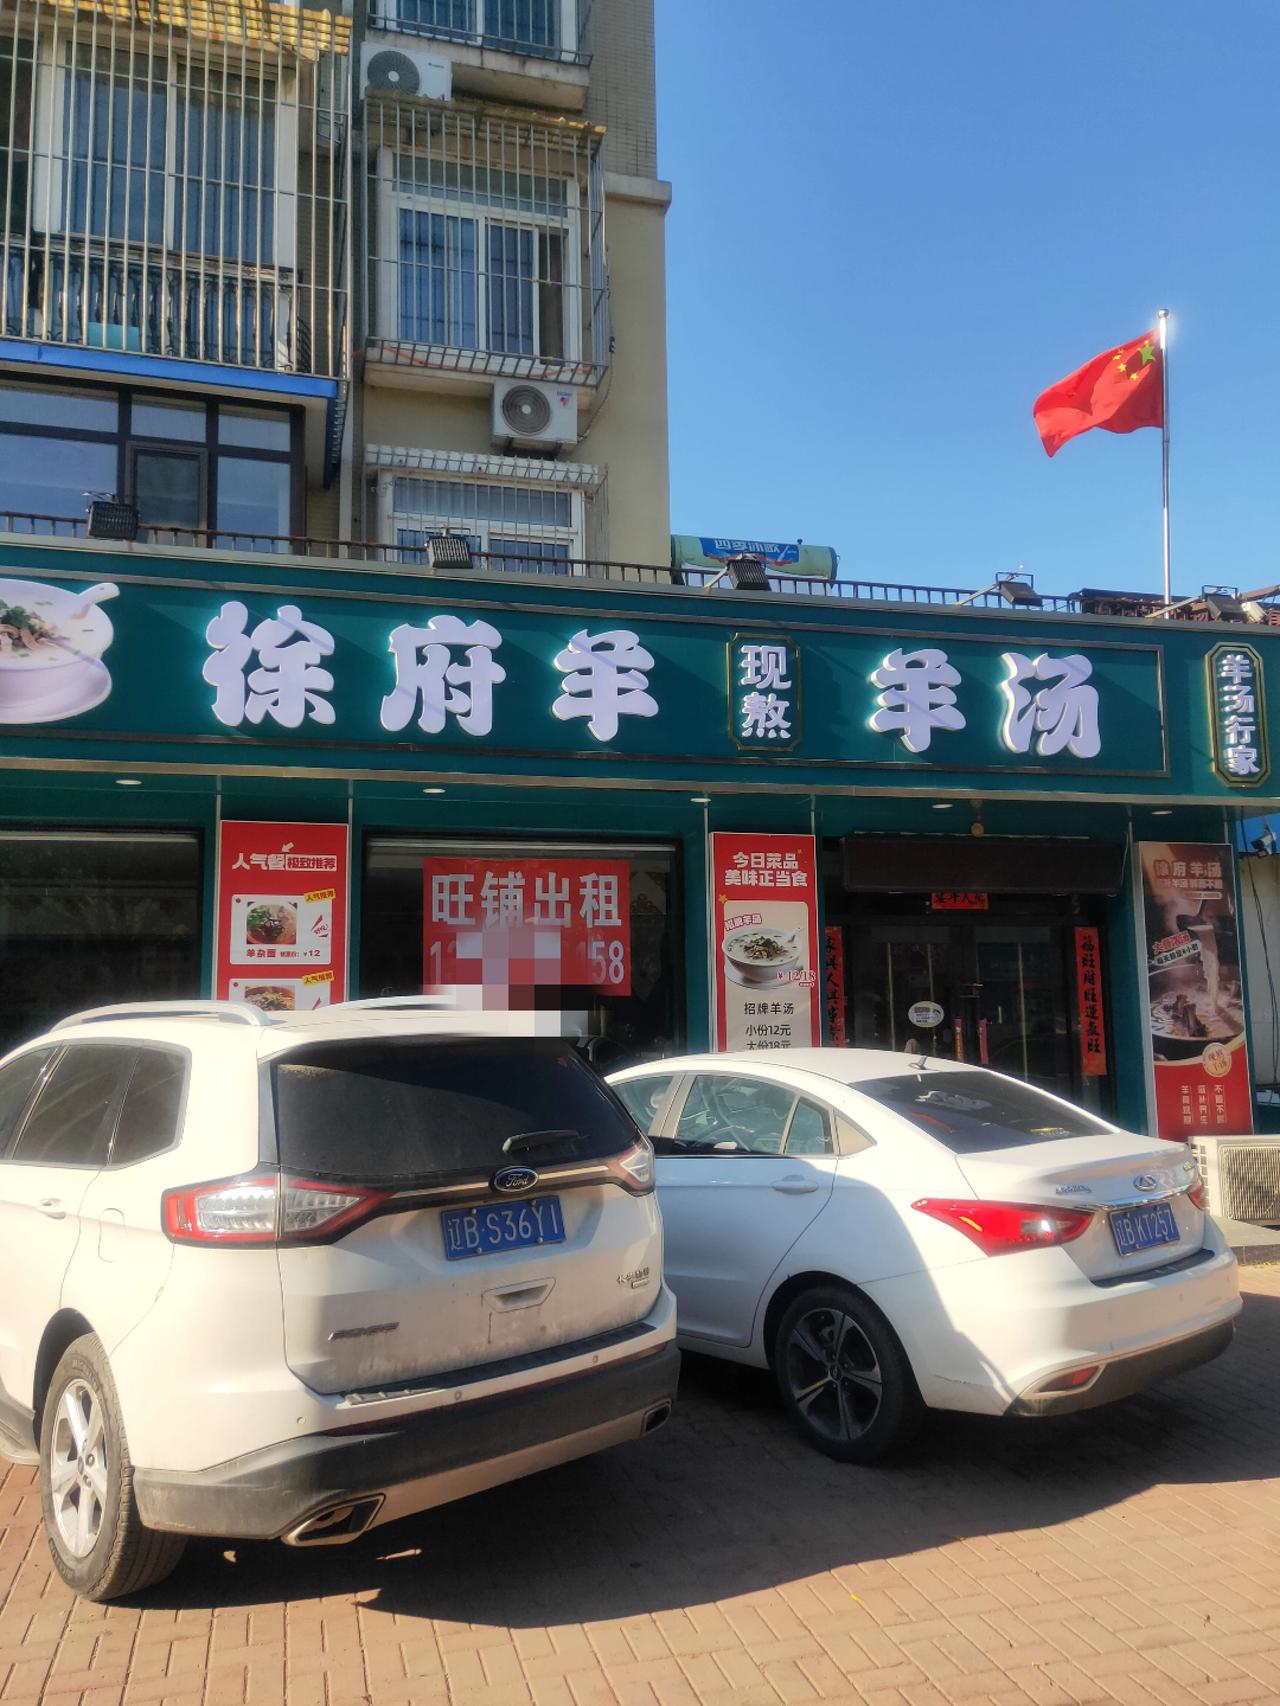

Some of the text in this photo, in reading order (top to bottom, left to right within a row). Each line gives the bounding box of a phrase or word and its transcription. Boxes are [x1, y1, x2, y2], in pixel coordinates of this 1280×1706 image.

[740, 644, 792, 740] 现熬
[868, 648, 1102, 758] 羊汤
[1220, 654, 1261, 775] 羊汤行家
[725, 869, 808, 887] 美味正当食
[733, 852, 799, 869] 今日菜品
[431, 870, 622, 929] 旺铺出租
[744, 1002, 794, 1015] 招牌羊汤
[745, 1024, 791, 1037] 小份12元
